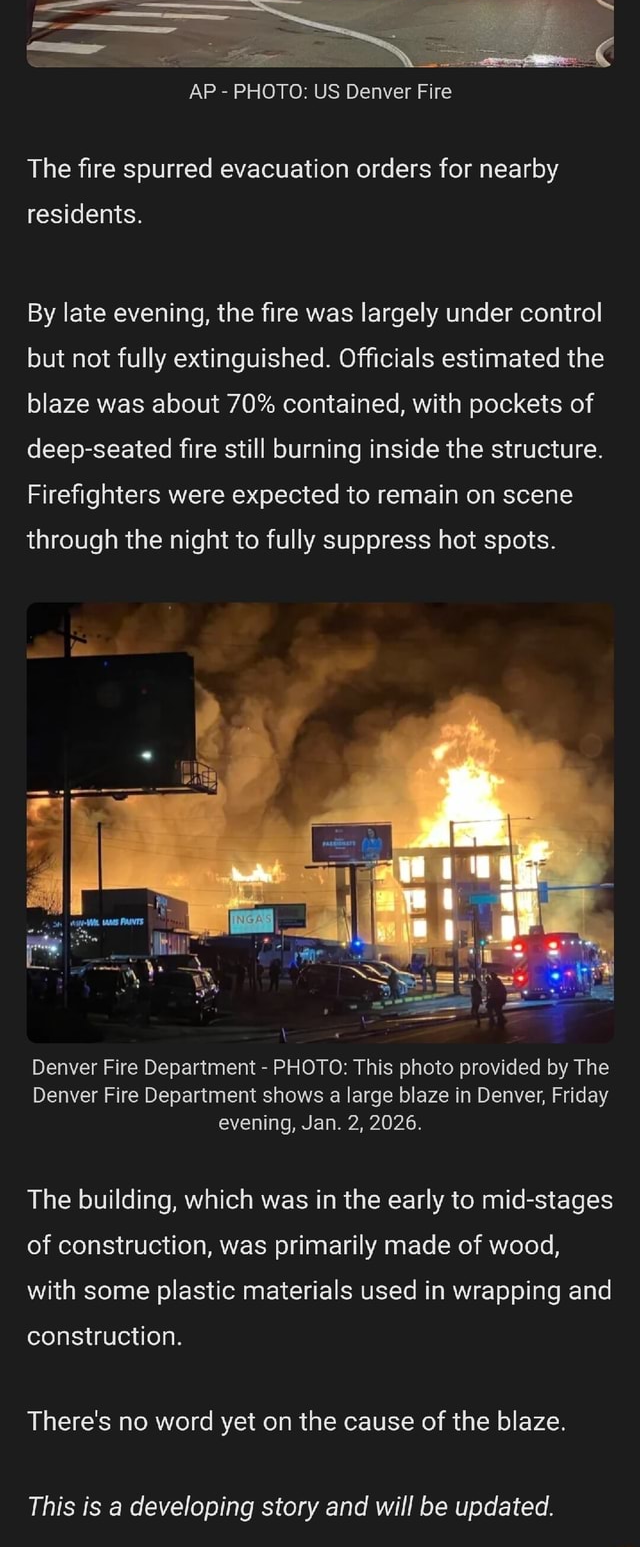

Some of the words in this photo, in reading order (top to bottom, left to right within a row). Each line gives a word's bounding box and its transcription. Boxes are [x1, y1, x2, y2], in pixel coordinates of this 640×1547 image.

[188, 83, 217, 100] AP
[233, 83, 308, 100] PHOTO:
[314, 83, 340, 100] US
[346, 83, 412, 100] Denver
[417, 83, 453, 100] Fire
[26, 156, 72, 179] The
[77, 156, 116, 179] fire
[123, 156, 213, 184] spurred
[220, 158, 349, 179] evacuation
[356, 156, 432, 179] orders
[438, 156, 473, 179] for
[479, 156, 560, 185] nearby
[27, 202, 142, 225] residents.
[28, 302, 57, 329] By
[63, 301, 107, 323] late
[113, 302, 210, 329] evening,
[216, 301, 255, 323] the
[260, 301, 299, 323] fire
[305, 306, 354, 323] was
[361, 301, 440, 329] largely
[446, 301, 514, 323] under
[520, 301, 602, 323] control
[28, 482, 161, 510] Firefighters
[167, 488, 226, 505] were
[232, 482, 340, 510] expected
[345, 485, 370, 505] to
[377, 483, 459, 505] remain
[466, 488, 495, 505] on
[502, 488, 574, 505] scene
[25, 528, 118, 555] through
[124, 528, 163, 550] the
[170, 528, 230, 556] night
[234, 530, 260, 550] to
[265, 528, 317, 556] fully
[322, 533, 432, 555] suppress
[438, 528, 477, 550] hot
[483, 530, 556, 555] spots.
[120, 917, 144, 926] PAINTS
[32, 1058, 98, 1076] Denver
[103, 1058, 139, 1076] Fire
[144, 1058, 257, 1080] Department
[273, 1058, 348, 1076] PHOTO:
[352, 1057, 394, 1076] This
[399, 1057, 454, 1080] photo
[459, 1057, 541, 1080] provided
[547, 1057, 569, 1080] by
[573, 1057, 610, 1076] The
[33, 1086, 99, 1104] Denver
[104, 1086, 139, 1104] Fire
[144, 1086, 257, 1108] Department
[262, 1085, 324, 1104] shows
[329, 1090, 341, 1104] a
[347, 1085, 394, 1108] large
[399, 1085, 450, 1104] blaze
[455, 1086, 472, 1104] in
[477, 1086, 546, 1106] Denver,
[552, 1085, 610, 1108] Friday
[218, 1114, 296, 1136] evening,
[300, 1114, 342, 1131] Jan.
[347, 1114, 364, 1134] 2,
[369, 1114, 422, 1131] 2026.
[26, 1187, 72, 1210] The
[78, 1187, 177, 1216] building,
[184, 1187, 254, 1210] which
[260, 1193, 309, 1210] was
[316, 1188, 337, 1210] in
[342, 1187, 381, 1210] the
[387, 1187, 446, 1216] early
[450, 1190, 475, 1210] to
[482, 1187, 614, 1216] mid-stages
[27, 1233, 52, 1256] of
[58, 1234, 213, 1259] construction,
[218, 1239, 267, 1256] was
[275, 1233, 378, 1261] primarily
[384, 1233, 451, 1256] made
[457, 1233, 483, 1256] of
[488, 1233, 560, 1259] wood,
[27, 1325, 182, 1347] construction.
[26, 1409, 112, 1432] There's
[119, 1415, 149, 1432] no
[154, 1409, 213, 1432] word
[220, 1412, 256, 1437] yet
[262, 1415, 292, 1432] on
[298, 1409, 337, 1432] the
[343, 1415, 415, 1432] cause
[421, 1409, 447, 1432] of
[451, 1409, 490, 1432] the
[497, 1409, 566, 1432] blaze.
[28, 1494, 76, 1517] This
[82, 1495, 102, 1517] is
[108, 1500, 123, 1517] a
[129, 1494, 255, 1523] developing
[261, 1496, 320, 1523] story
[325, 1494, 370, 1517] and
[375, 1494, 415, 1517] will
[419, 1494, 449, 1517] be
[455, 1494, 554, 1522] updated.
